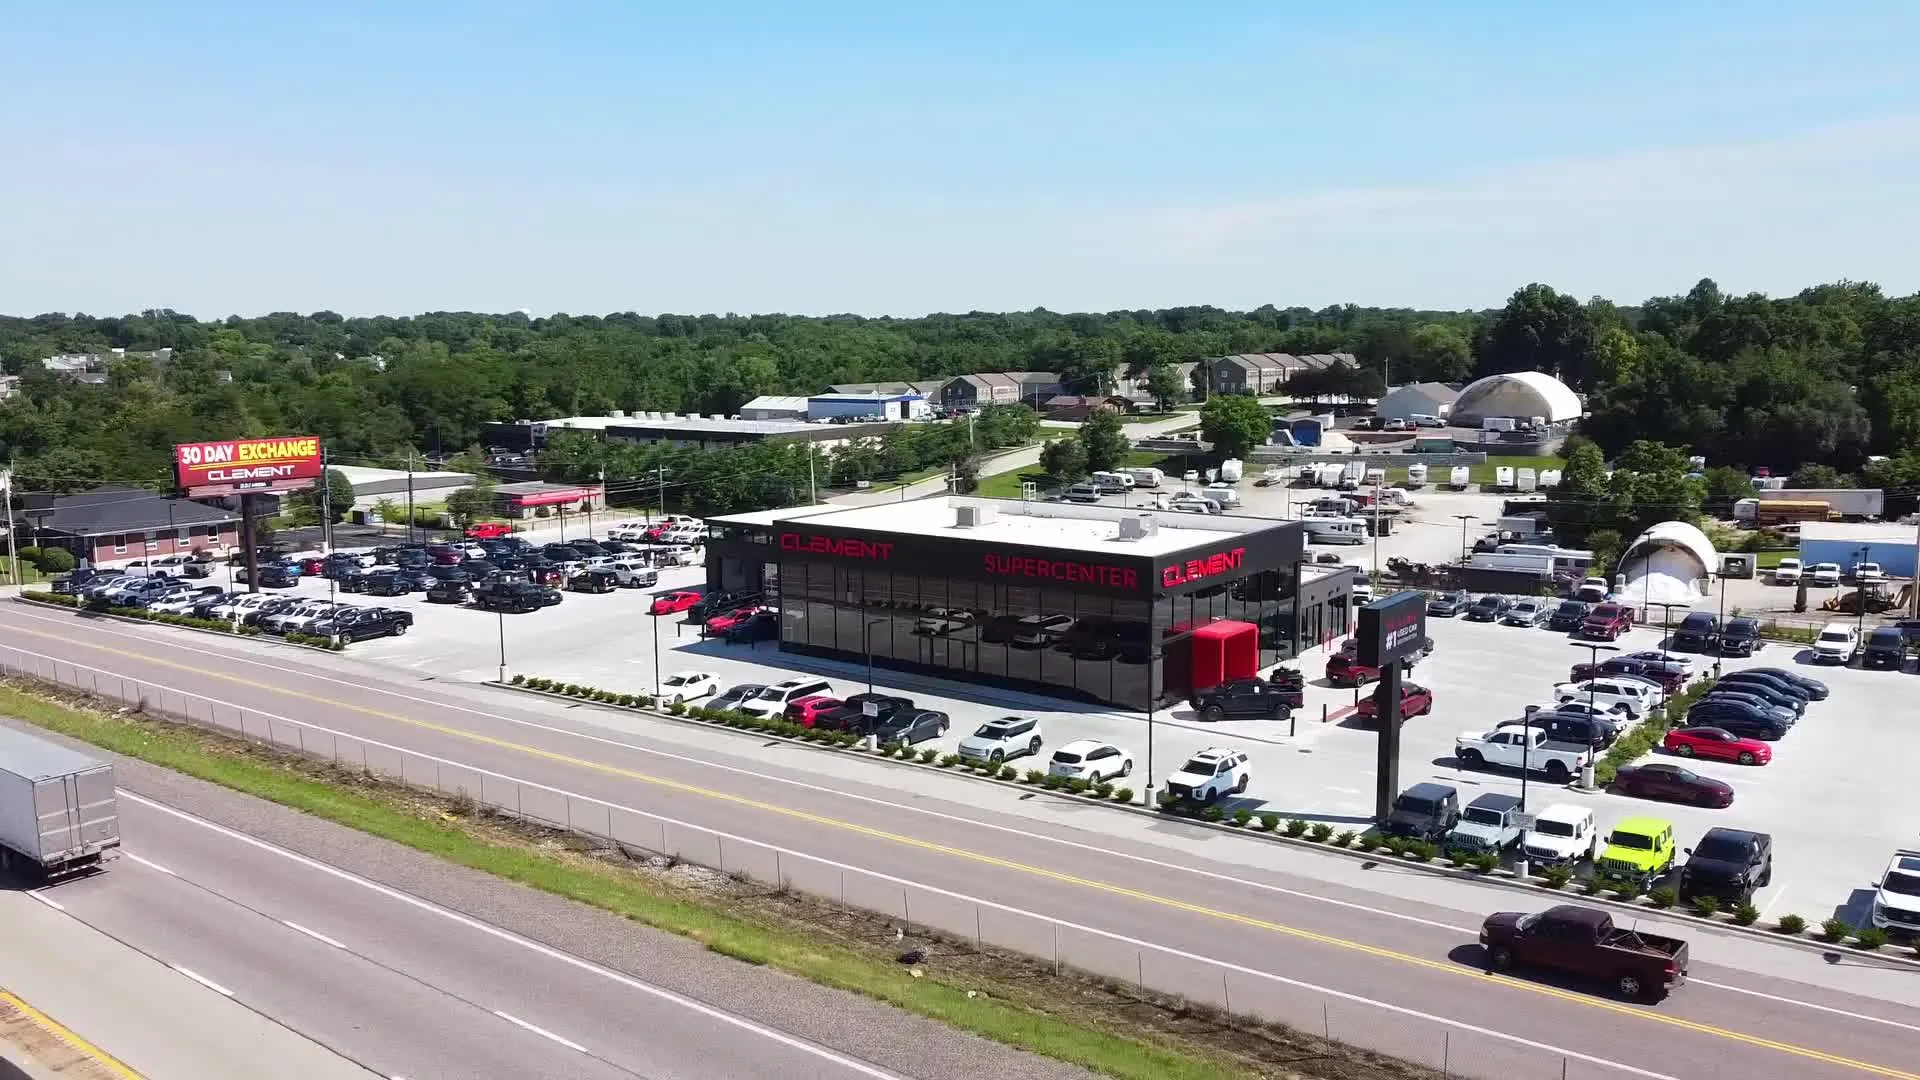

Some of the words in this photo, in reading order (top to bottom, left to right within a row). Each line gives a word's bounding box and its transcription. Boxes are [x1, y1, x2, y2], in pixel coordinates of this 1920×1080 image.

[181, 444, 201, 464] 30
[204, 445, 234, 463] DAY
[239, 439, 317, 461] EXCHANGE
[207, 465, 295, 481] CLEMENT
[780, 533, 894, 559] CLEMENT
[984, 552, 1138, 590] SUPERCENTER
[1162, 547, 1246, 588] CLEMENT
